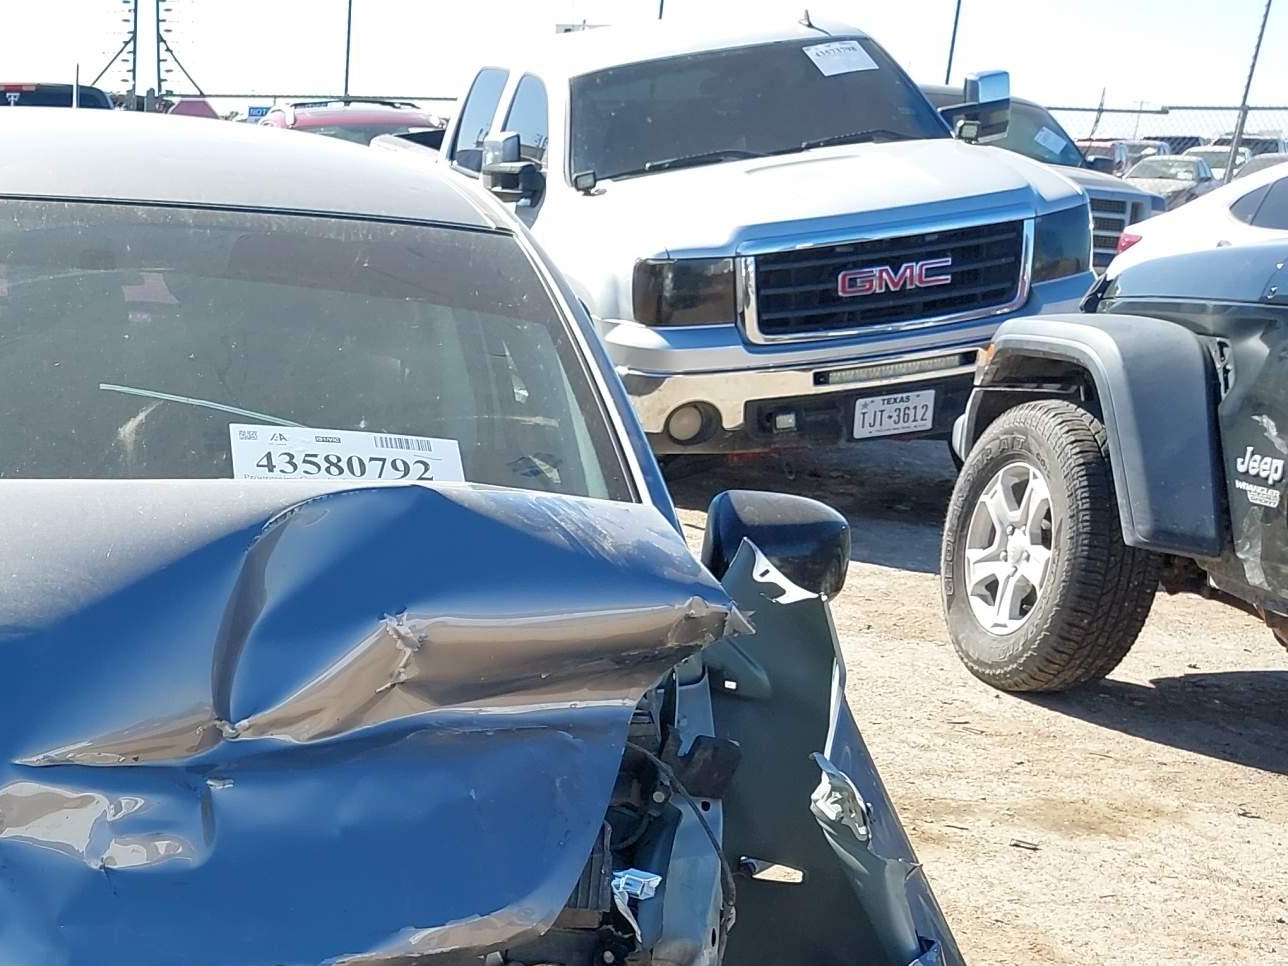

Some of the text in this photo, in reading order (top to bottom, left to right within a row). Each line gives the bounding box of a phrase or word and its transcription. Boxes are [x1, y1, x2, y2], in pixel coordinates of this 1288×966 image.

[838, 257, 952, 297] GMC
[882, 395, 911, 406] TEXAS
[256, 451, 435, 481] 43580792
[1236, 446, 1285, 485] Jeep
